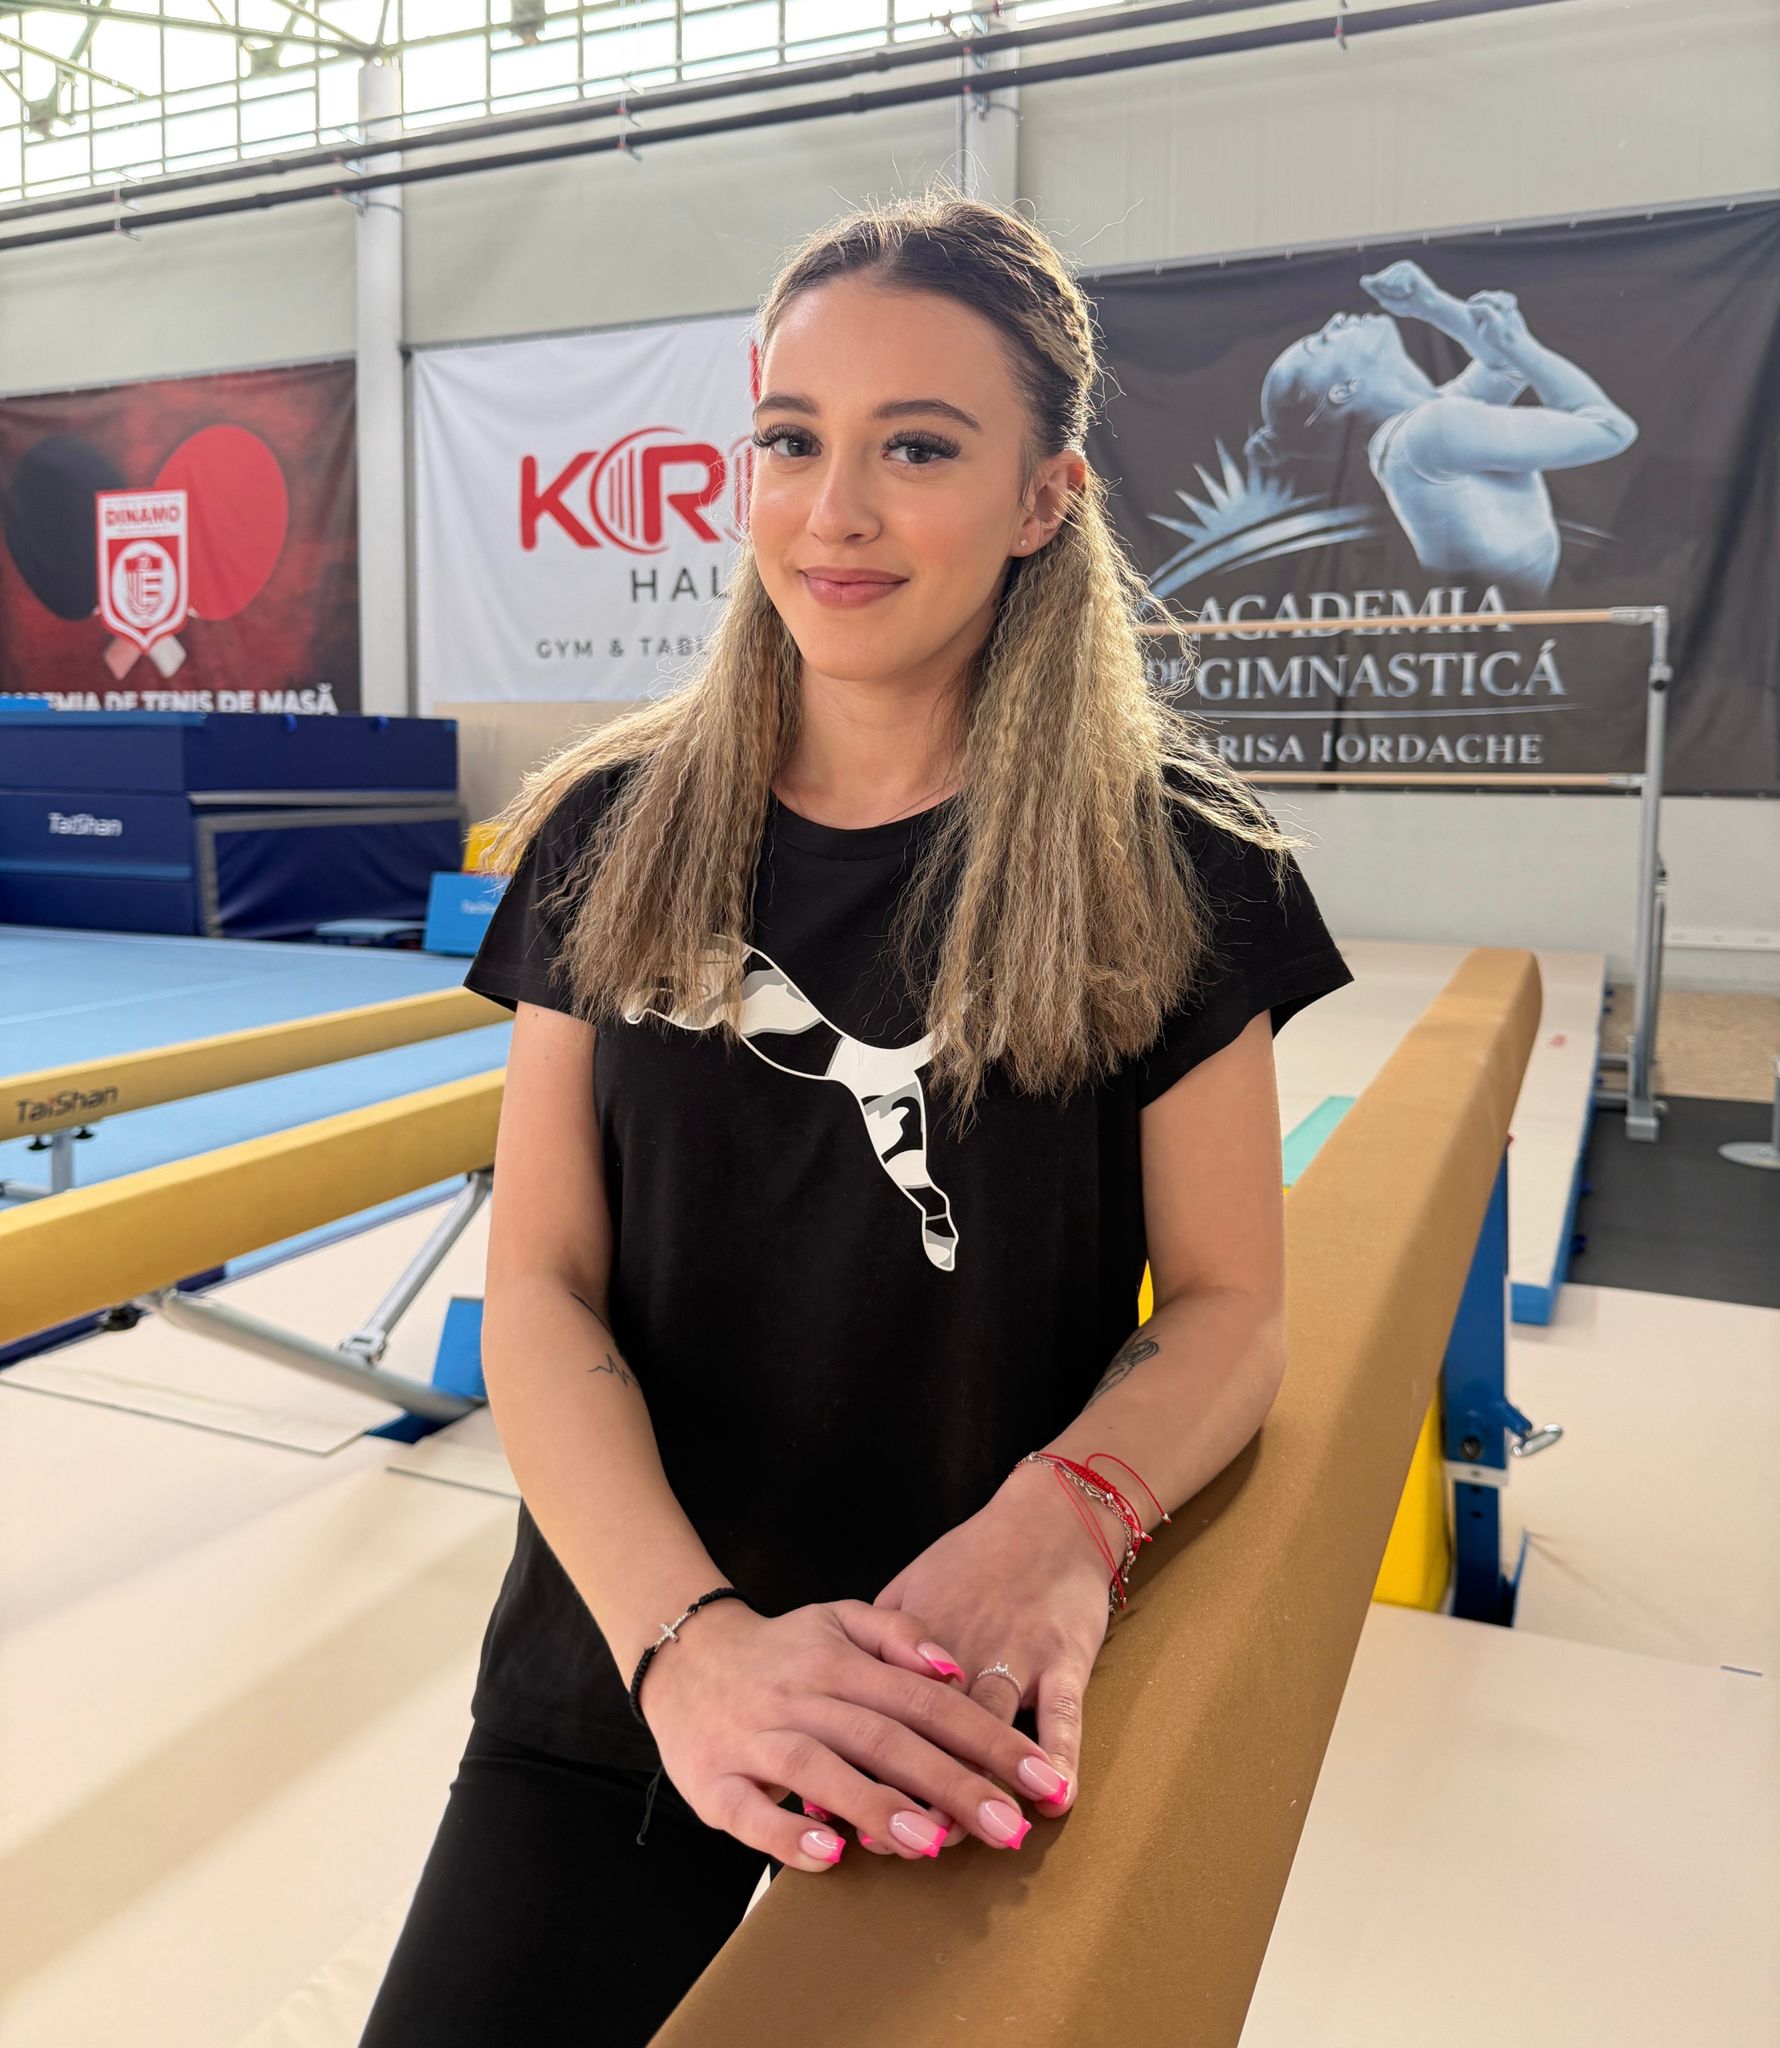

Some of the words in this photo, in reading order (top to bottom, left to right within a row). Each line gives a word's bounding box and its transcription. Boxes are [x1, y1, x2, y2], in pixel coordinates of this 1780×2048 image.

[105, 506, 180, 527] DINAMO
[630, 565, 730, 603] HAL
[1193, 584, 1513, 641] ACADEMIA
[536, 637, 593, 660] GYM
[609, 636, 625, 658] &
[104, 690, 138, 712] DE
[141, 689, 213, 713] TENIS
[217, 689, 251, 714] DE
[259, 682, 339, 716] MASĂ
[1321, 730, 1544, 765] IORDACHE
[48, 812, 123, 837] TaiShan
[17, 1086, 119, 1124] TaiShan
